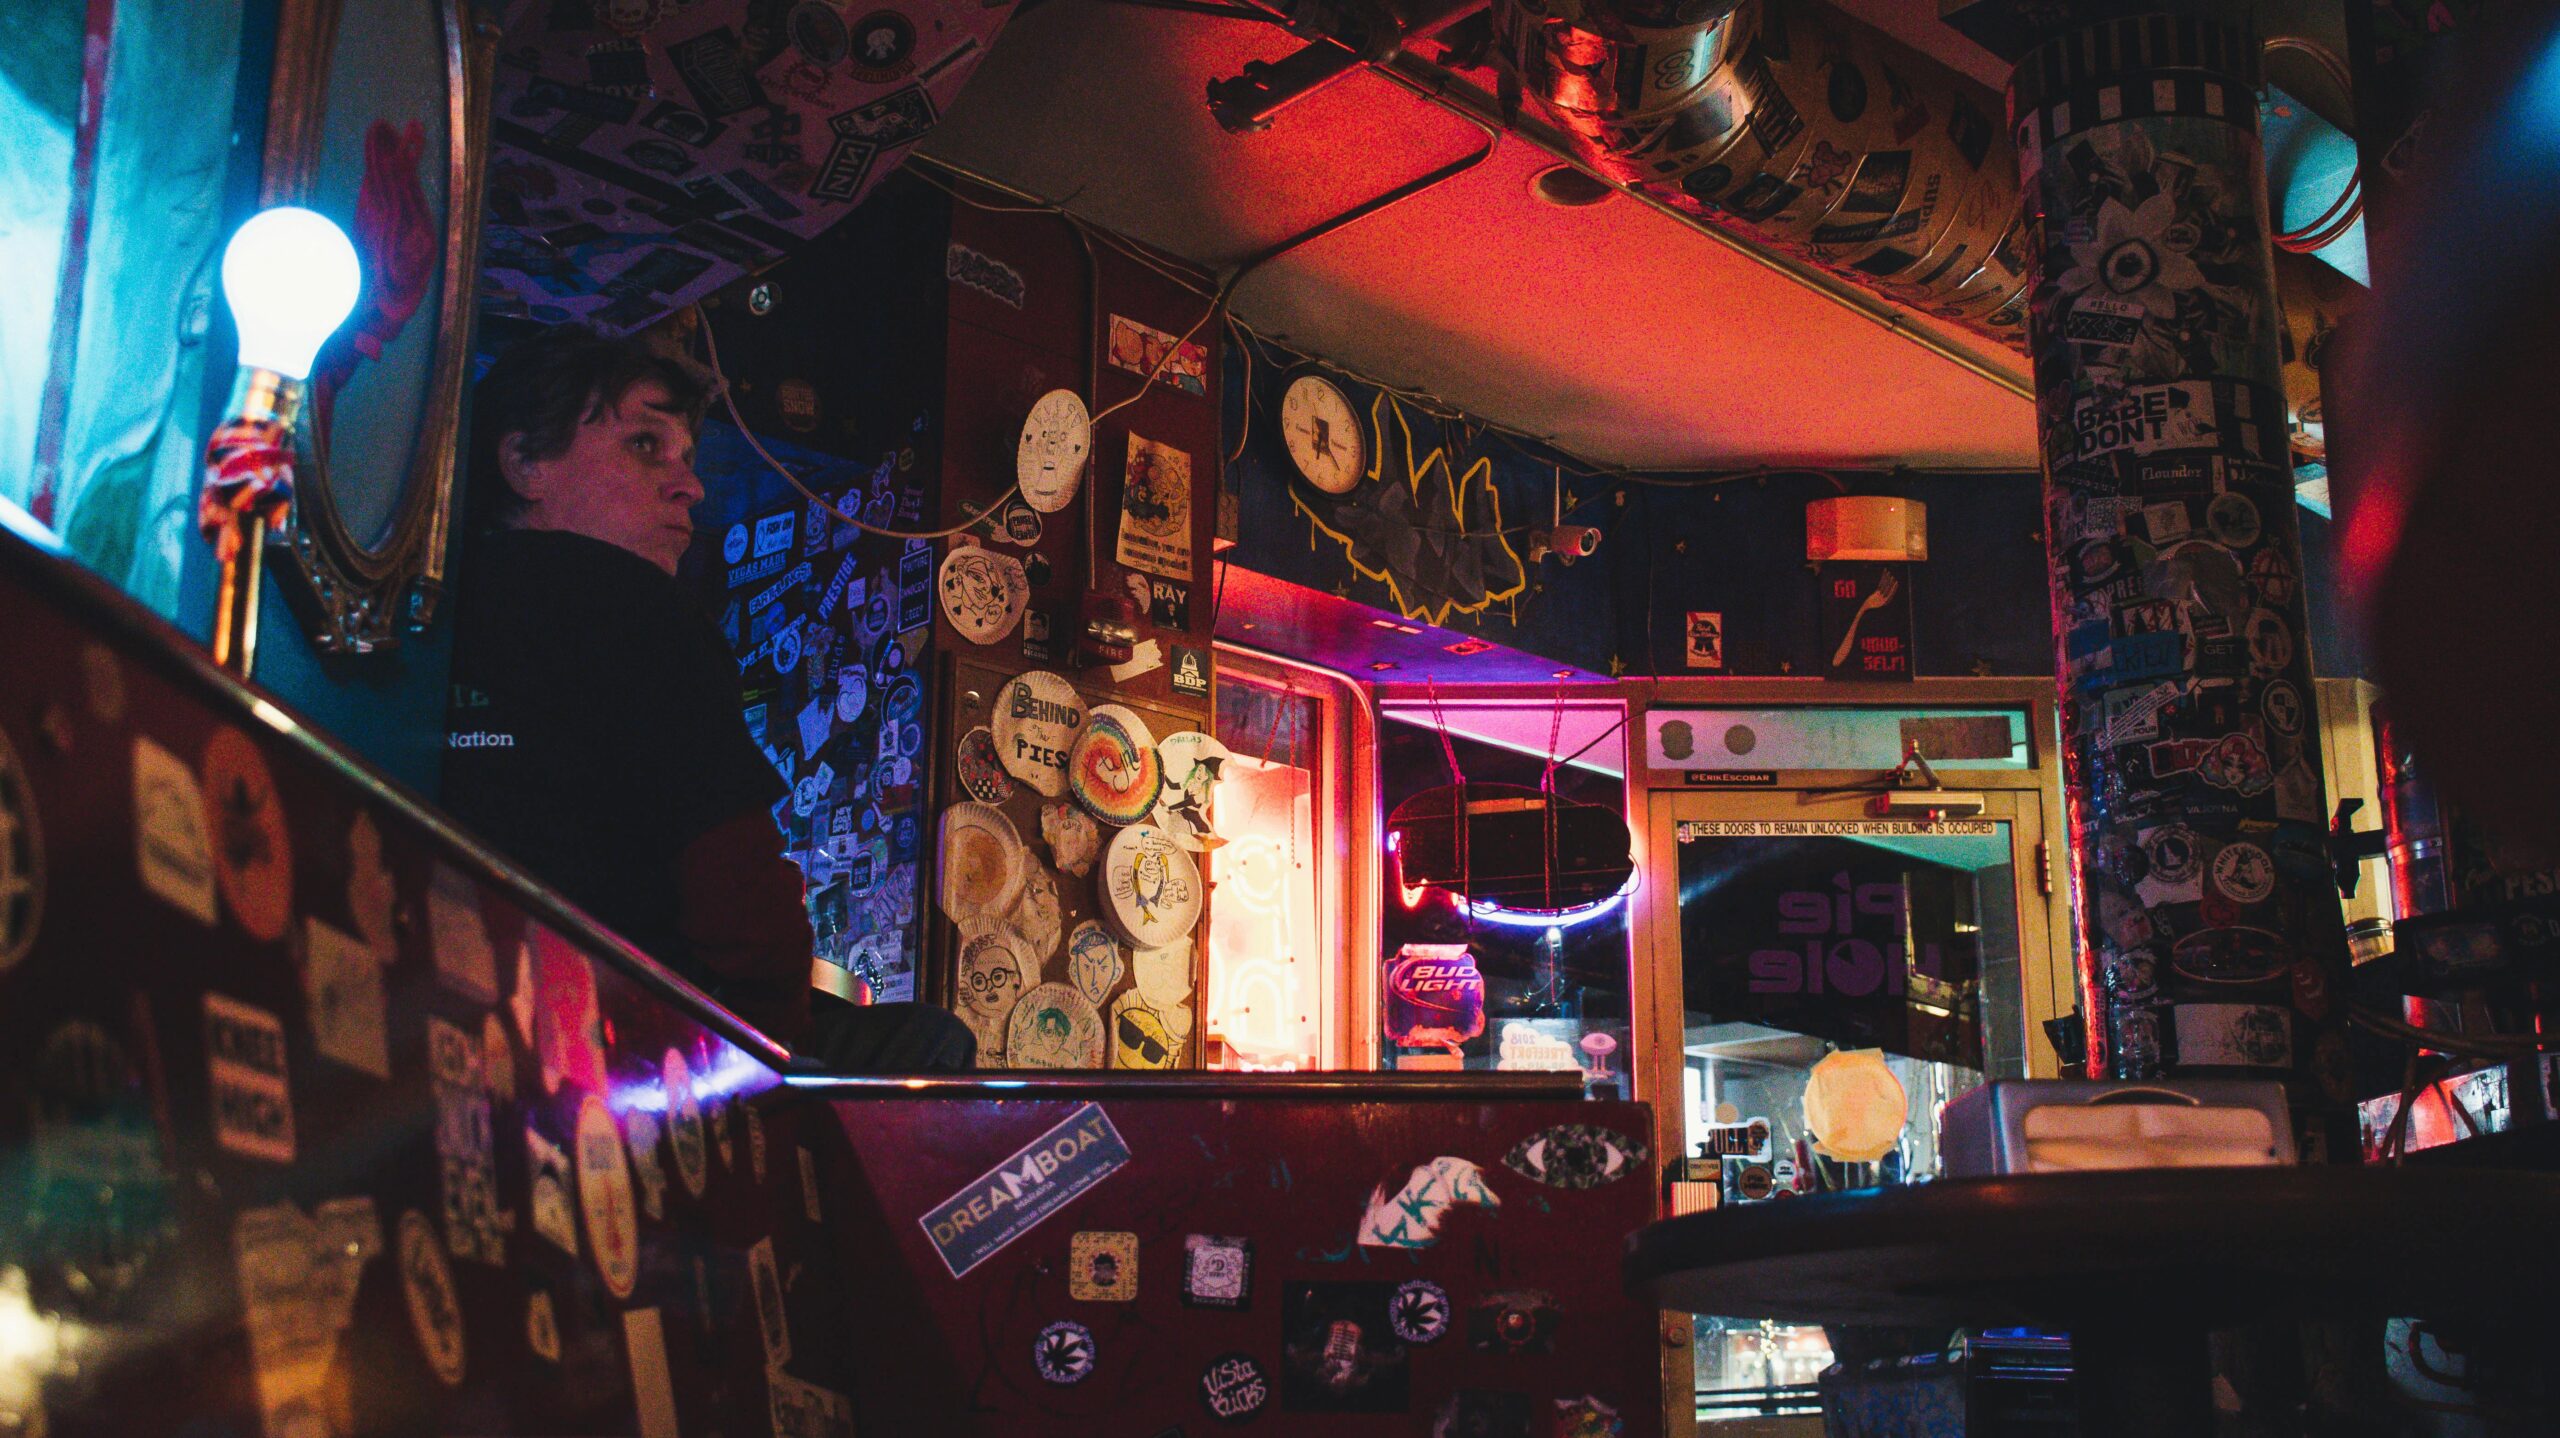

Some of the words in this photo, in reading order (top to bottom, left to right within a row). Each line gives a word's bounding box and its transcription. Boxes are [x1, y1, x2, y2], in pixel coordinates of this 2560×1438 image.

[2077, 391, 2167, 432] BABE
[2077, 416, 2168, 457] DONT
[817, 551, 858, 621] PRESTIGE
[1153, 580, 1188, 605] RAY
[1834, 580, 1857, 599] GO
[1099, 645, 1125, 660] FIRE
[2204, 643, 2236, 656] GET
[1172, 673, 1208, 688] BDP
[447, 730, 516, 750] Nation
[1016, 739, 1070, 770] PIES
[1692, 823, 1721, 835] THESE
[1724, 823, 1756, 835] DOORS
[1759, 823, 1771, 835] TO
[1774, 823, 1808, 835] REMAIN
[1811, 823, 1859, 835] UNLOCKED
[1862, 823, 1889, 835] WHEN
[1893, 823, 1933, 835] BUILDING
[1936, 823, 1945, 835] IS
[1948, 823, 1994, 835] OCCUPIED
[1411, 965, 1477, 978] BUD
[1402, 978, 1482, 992] LIGHT
[930, 1113, 1109, 1247] DREAMBOAT
[1017, 1210, 1038, 1227] YOUR
[1068, 1174, 1090, 1192] COME
[1090, 1159, 1112, 1177] TRUE
[1203, 1359, 1258, 1396] Vista
[1208, 1377, 1268, 1417] Kicks
